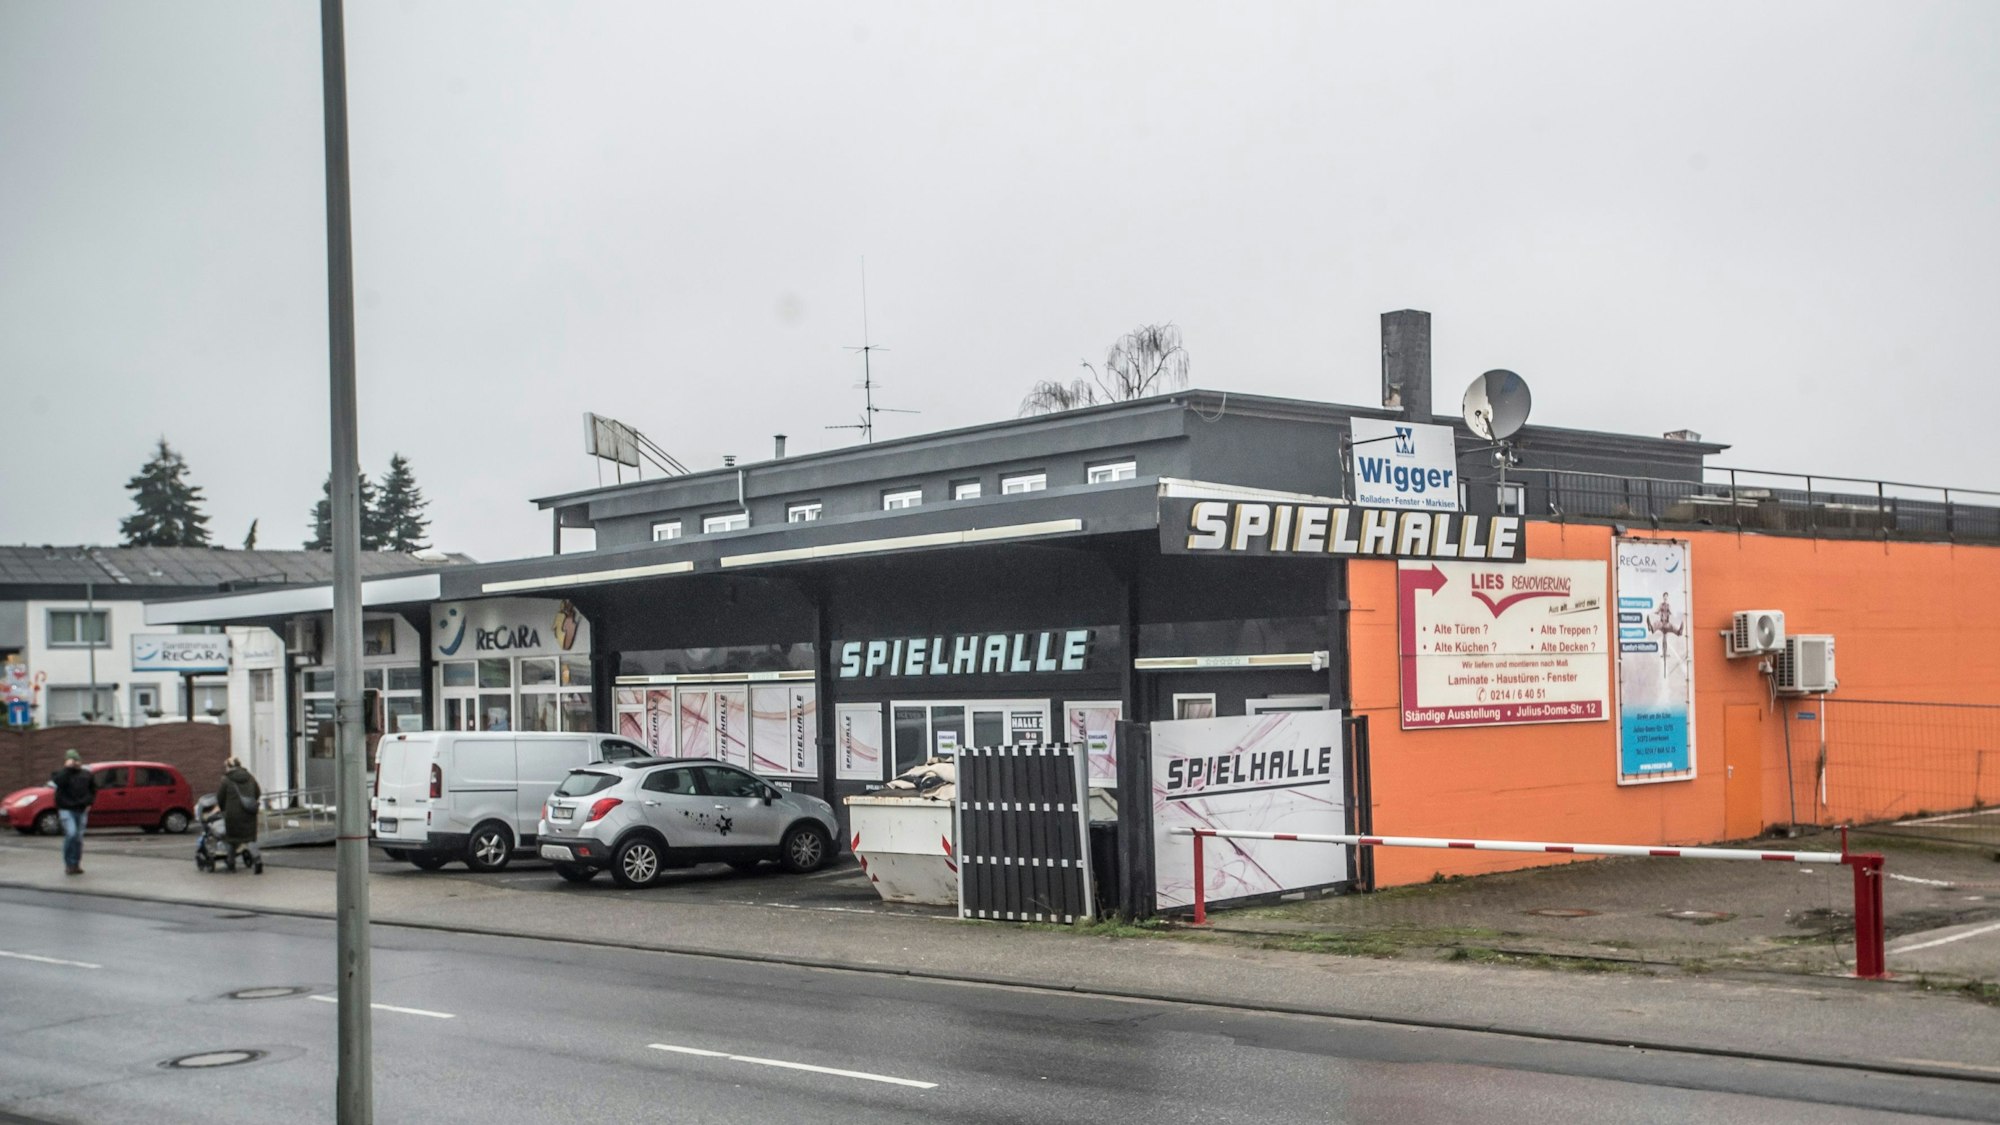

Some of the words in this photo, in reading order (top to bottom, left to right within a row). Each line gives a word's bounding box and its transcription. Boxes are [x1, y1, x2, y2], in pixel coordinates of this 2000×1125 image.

[1358, 456, 1453, 493] Wigger
[1360, 494, 1390, 505] Rolladen
[1395, 496, 1420, 506] Fenster
[1425, 498, 1456, 508] Markisen
[1187, 502, 1518, 559] SPIELHALLE
[1471, 573, 1504, 590] LIES
[1512, 575, 1571, 593] RENOVIERUNG
[1434, 624, 1452, 634] Alte
[1455, 624, 1480, 634] Türen
[1541, 625, 1557, 635] Alte
[1559, 625, 1591, 637] Treppen
[840, 629, 1090, 678] SPIELHALLE
[1434, 642, 1452, 652] Alte
[1455, 642, 1489, 652] Küchen
[1541, 642, 1557, 652] Alte
[1560, 642, 1589, 652] Decken
[1462, 661, 1473, 669] Wir
[1475, 661, 1494, 669] liefern
[1509, 660, 1539, 668] montieren
[1448, 675, 1489, 685] Laminate
[1496, 673, 1540, 684] Haustüren
[1547, 672, 1578, 683] Fenster
[1490, 689, 1511, 700] 0214
[1525, 688, 1535, 699] 40
[1537, 688, 1546, 698] 51
[1405, 709, 1446, 723] Ständige
[1447, 708, 1501, 721] Ausstellung
[1516, 703, 1585, 717] Julius-Doms-Str.
[1587, 702, 1596, 713] 12
[1012, 717, 1038, 728] HALLE
[1167, 746, 1332, 790] SPIELHALLE
